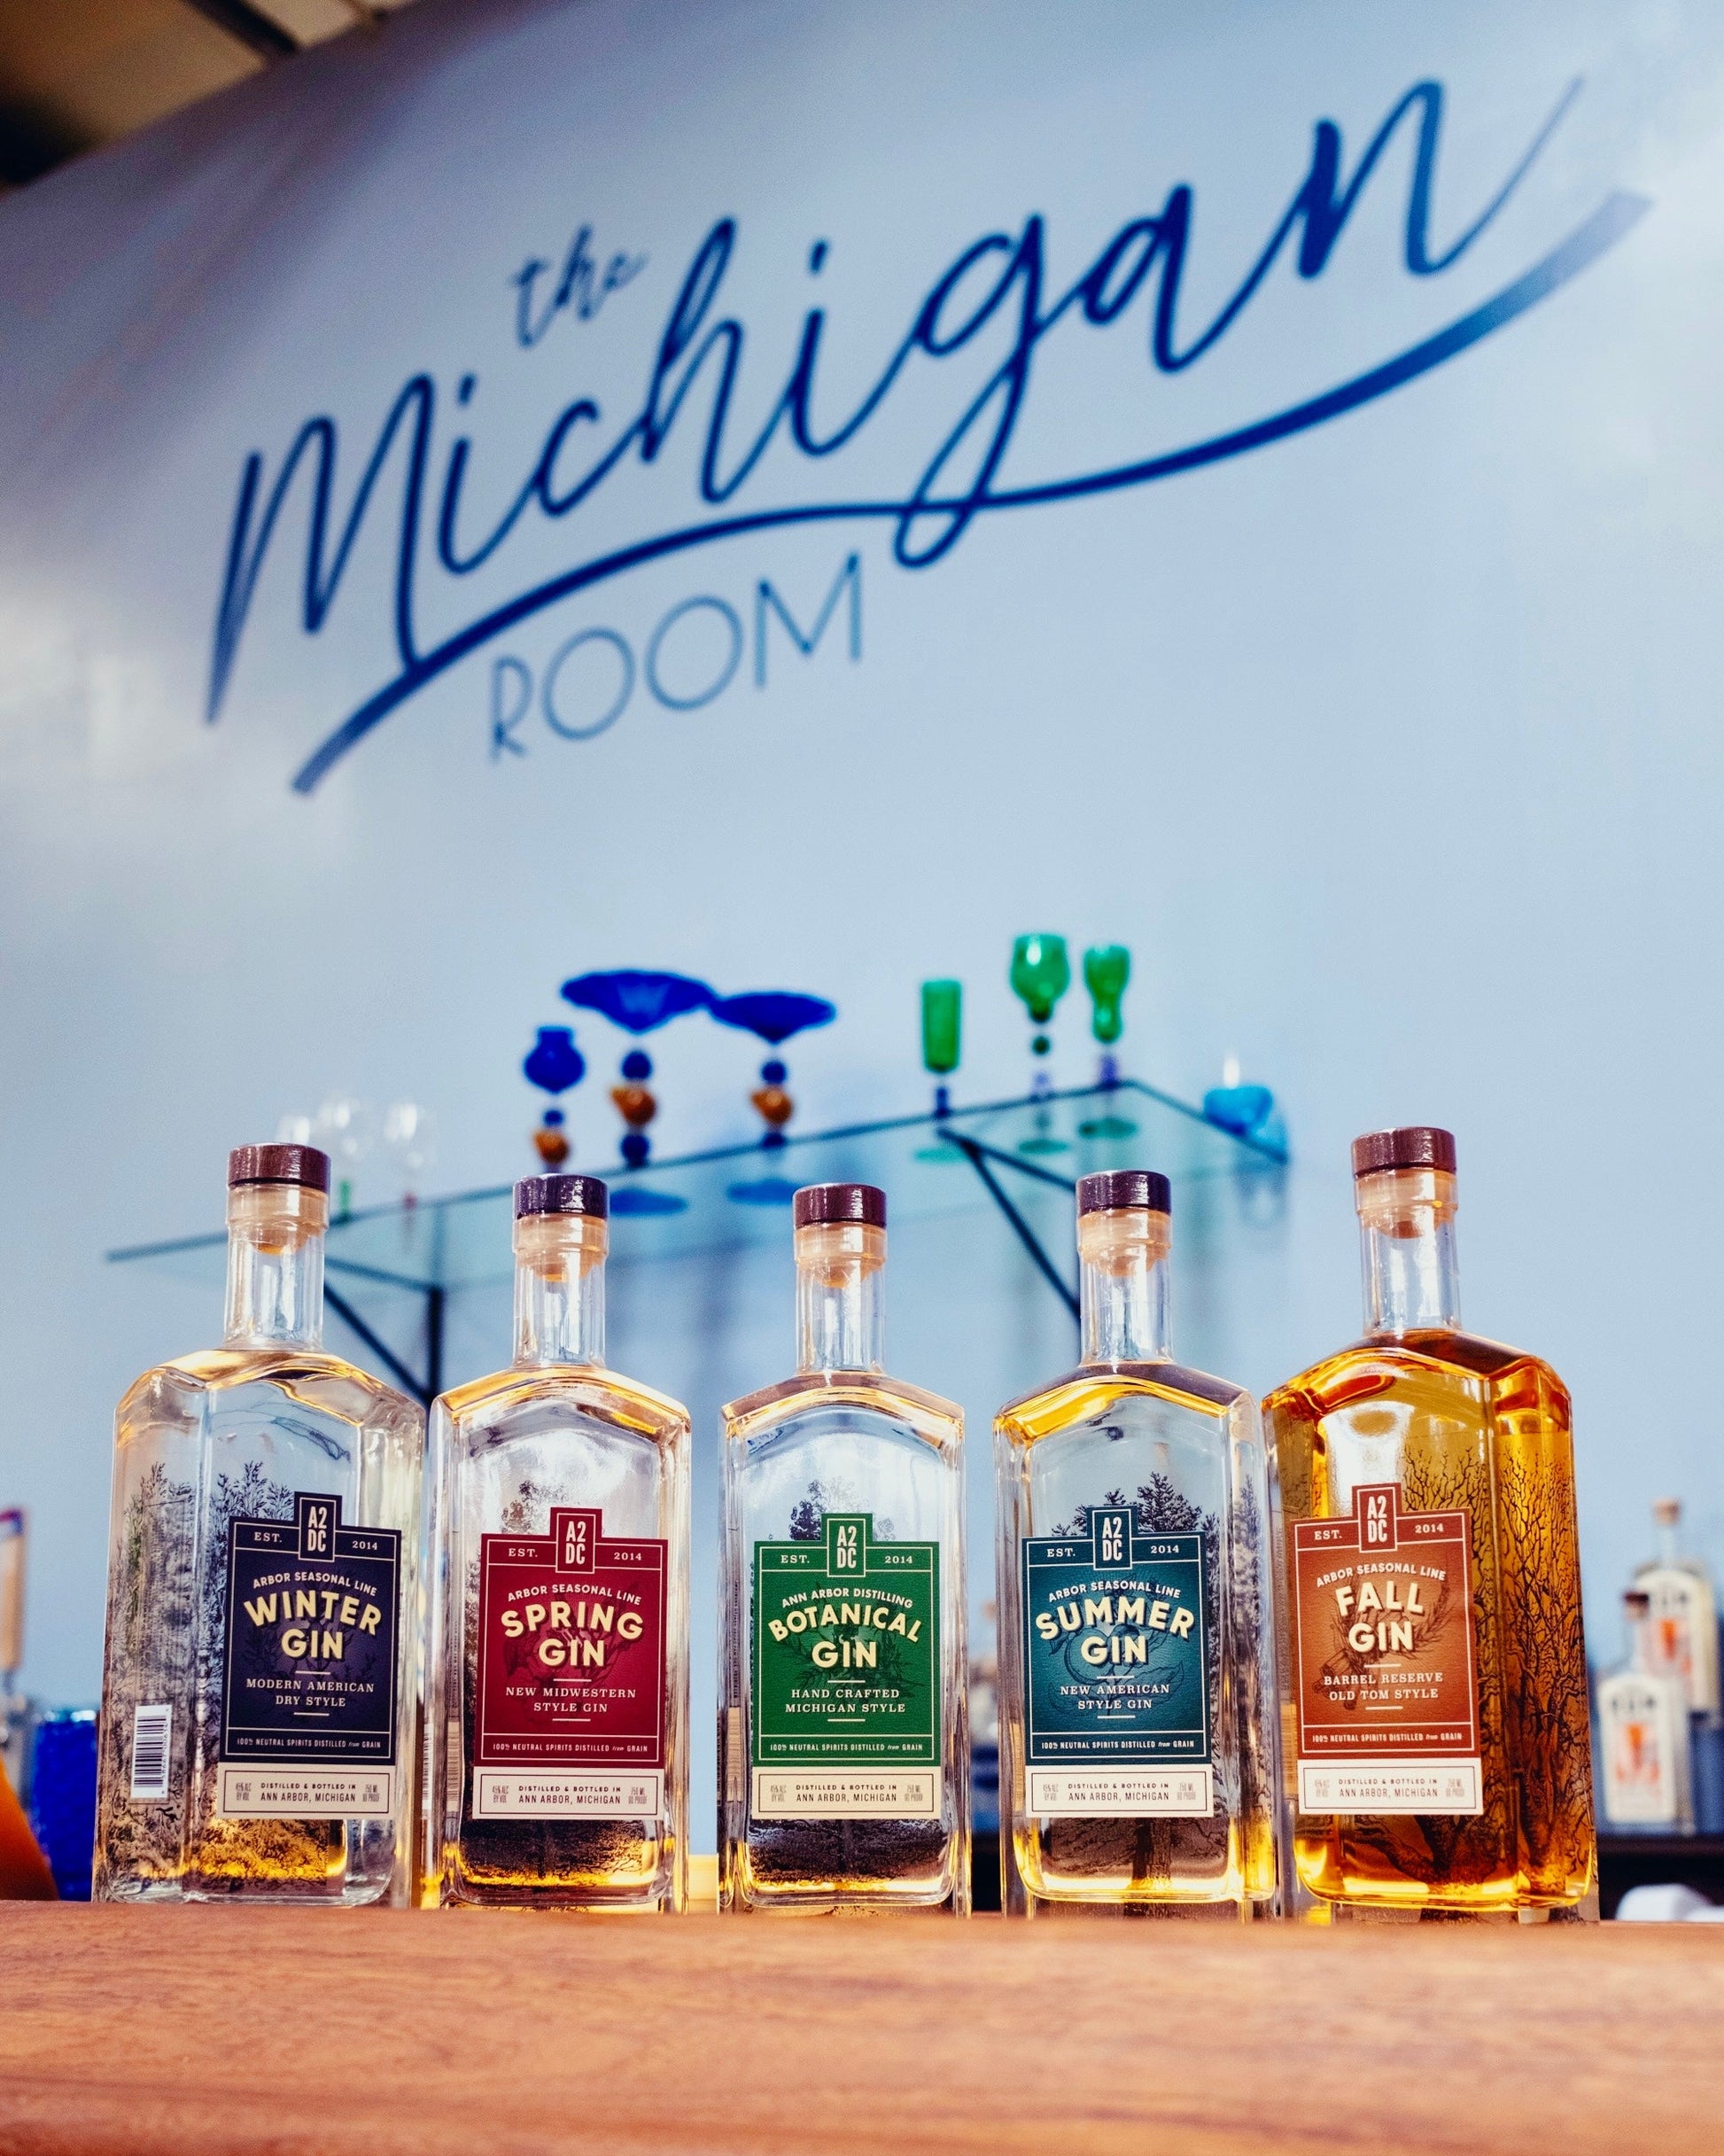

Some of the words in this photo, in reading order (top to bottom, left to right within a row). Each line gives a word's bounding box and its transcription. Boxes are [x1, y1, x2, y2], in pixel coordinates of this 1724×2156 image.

[510, 226, 650, 347] the
[206, 77, 1586, 727] Michigan
[488, 553, 865, 764] ROOM
[308, 1506, 327, 1529] A2
[1367, 1496, 1386, 1519] A2
[253, 1532, 283, 1543] EST.
[566, 1522, 586, 1543] A2
[837, 1526, 857, 1546] A2
[1102, 1517, 1122, 1538] A2
[1314, 1529, 1342, 1540] EST.
[1368, 1520, 1387, 1543] DC
[1415, 1523, 1444, 1534] 2014
[307, 1529, 326, 1552] DC
[352, 1540, 378, 1550] 2014
[1103, 1539, 1122, 1561] DC
[1151, 1545, 1179, 1554] 2014
[509, 1548, 538, 1558] EST.
[565, 1543, 586, 1564] DC
[837, 1548, 857, 1568] DC
[1047, 1548, 1076, 1558] EST.
[252, 1572, 291, 1588] ARBOR
[294, 1572, 351, 1586] SEASONAL
[354, 1581, 377, 1596] LINE
[1316, 1567, 1354, 1587] ARBOR
[1357, 1563, 1417, 1576] SEASONAL
[1420, 1568, 1446, 1581] LINE
[508, 1584, 547, 1601] ARBOR
[552, 1584, 612, 1597] SEASONAL
[617, 1590, 641, 1605] LINE
[781, 1592, 808, 1607] ANN
[811, 1588, 850, 1599] ARBOR
[853, 1588, 913, 1608] DISTILLING
[1049, 1584, 1087, 1602] ARBOR
[1091, 1581, 1152, 1592] SEASONAL
[1155, 1584, 1180, 1598] LINE
[1335, 1580, 1424, 1616] FALL
[244, 1590, 382, 1635] WINTER
[501, 1601, 643, 1640] SPRING
[1036, 1597, 1194, 1640] SUMMER
[768, 1603, 922, 1643] BOTANICAL
[281, 1629, 343, 1659] GIN
[1348, 1622, 1414, 1653] GIN
[539, 1638, 604, 1667] GIN
[812, 1641, 876, 1668] GIN
[1081, 1636, 1146, 1664] GIN
[246, 1679, 302, 1690] MODERN
[307, 1681, 374, 1693] AMERICAN
[1324, 1673, 1376, 1685] BARREL
[1382, 1672, 1443, 1683] RESERVE
[506, 1687, 536, 1696] NEW
[543, 1687, 636, 1698] MIDWESTERN
[791, 1689, 830, 1698] HAND
[835, 1689, 899, 1698] CRAFTED
[1060, 1685, 1091, 1694] NEW
[1097, 1685, 1169, 1694] AMERICAN
[1330, 1690, 1355, 1701] OLD
[1361, 1689, 1390, 1700] TOM
[1394, 1688, 1438, 1699] STYLE
[276, 1695, 301, 1706] DRY
[307, 1696, 346, 1707] STYLE
[534, 1702, 577, 1712] STYLE
[583, 1703, 608, 1712] GIN
[786, 1703, 856, 1713] MICHIGAN
[861, 1703, 905, 1713] STYLE
[1078, 1701, 1122, 1709] STYLE
[1128, 1700, 1152, 1708] GIN
[281, 1793, 311, 1802] ARBOR,
[540, 1795, 572, 1805] ARBOR,
[818, 1794, 850, 1803] ARBOR,
[1090, 1793, 1122, 1802] ARBOR,
[1360, 1789, 1391, 1799] ARBOR,
